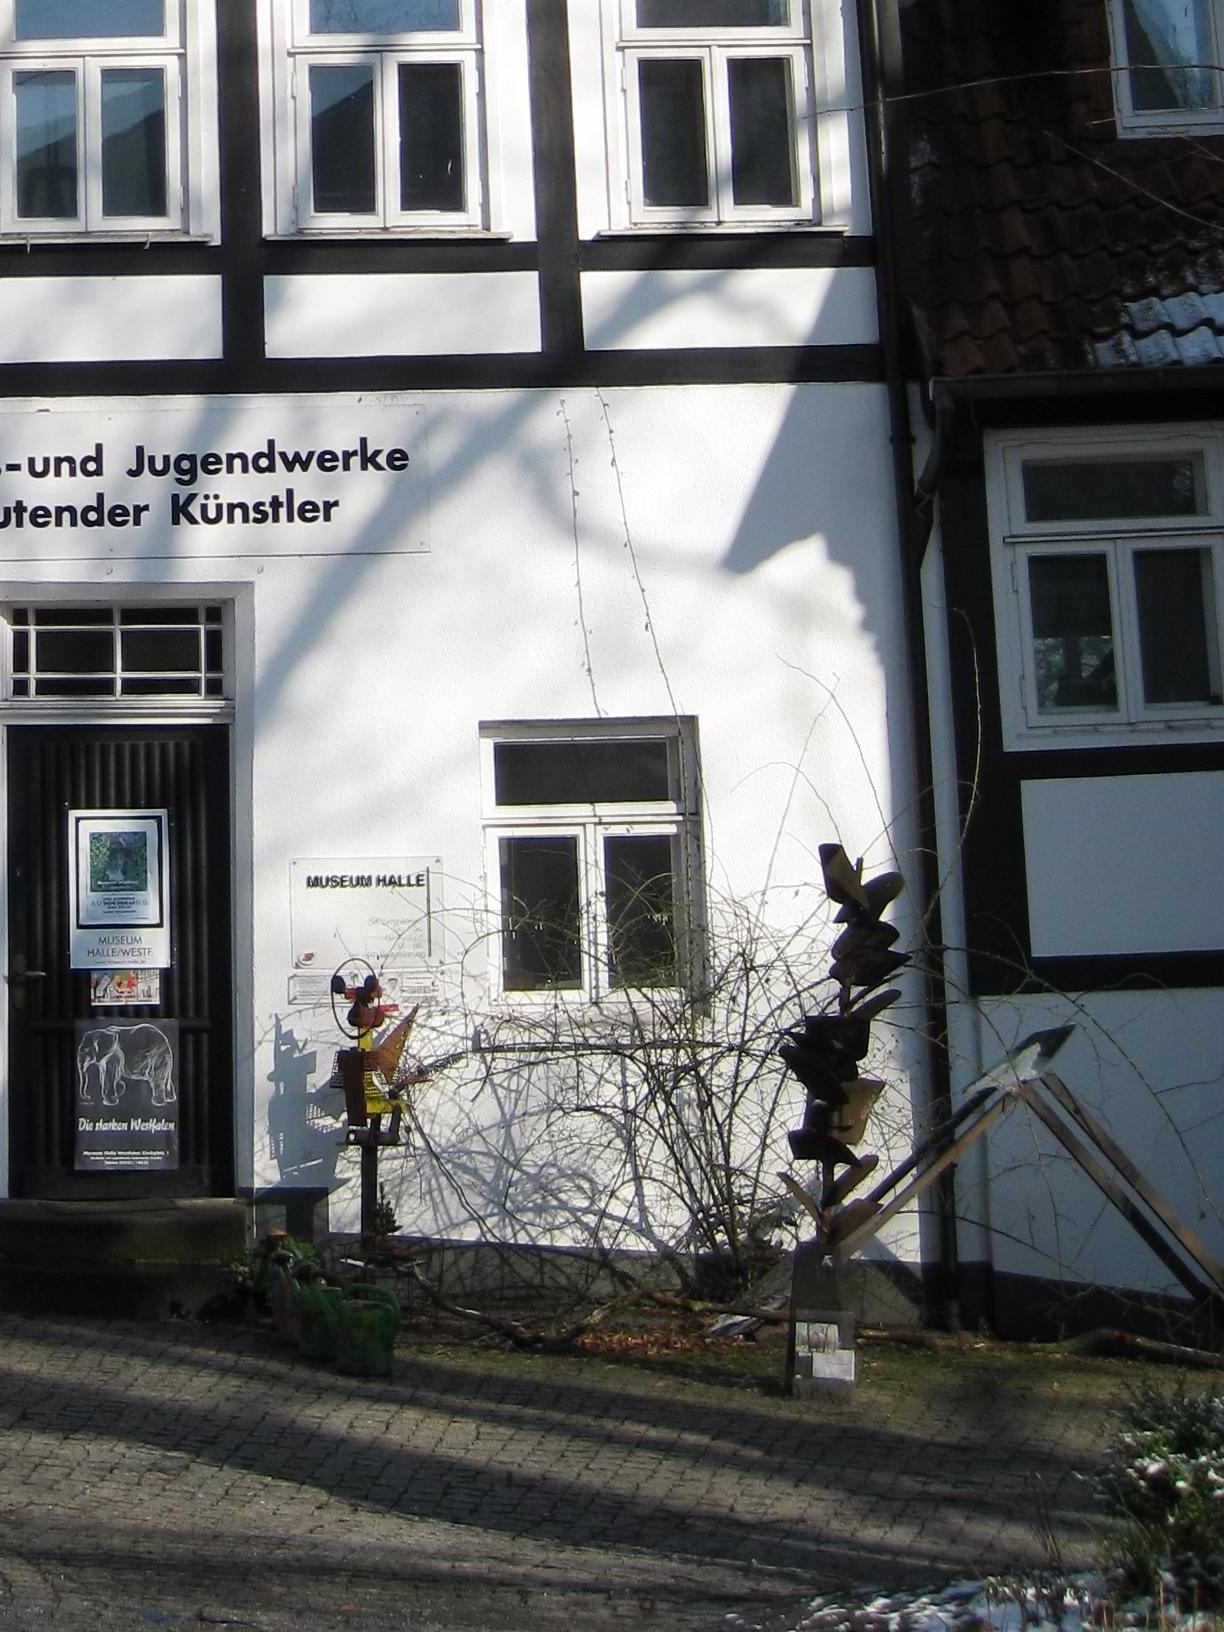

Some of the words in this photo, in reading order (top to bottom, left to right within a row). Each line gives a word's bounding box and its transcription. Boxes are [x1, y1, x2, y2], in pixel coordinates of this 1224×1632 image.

[126, 437, 410, 486] Jugendwerke
[170, 483, 339, 526] Künstler
[306, 874, 373, 888] MUSEUM
[376, 873, 425, 887] HALLE
[98, 935, 143, 945] MUSEUM
[78, 1117, 94, 1131] Die
[94, 1117, 129, 1131] starken
[130, 1117, 175, 1134] Westfalen
